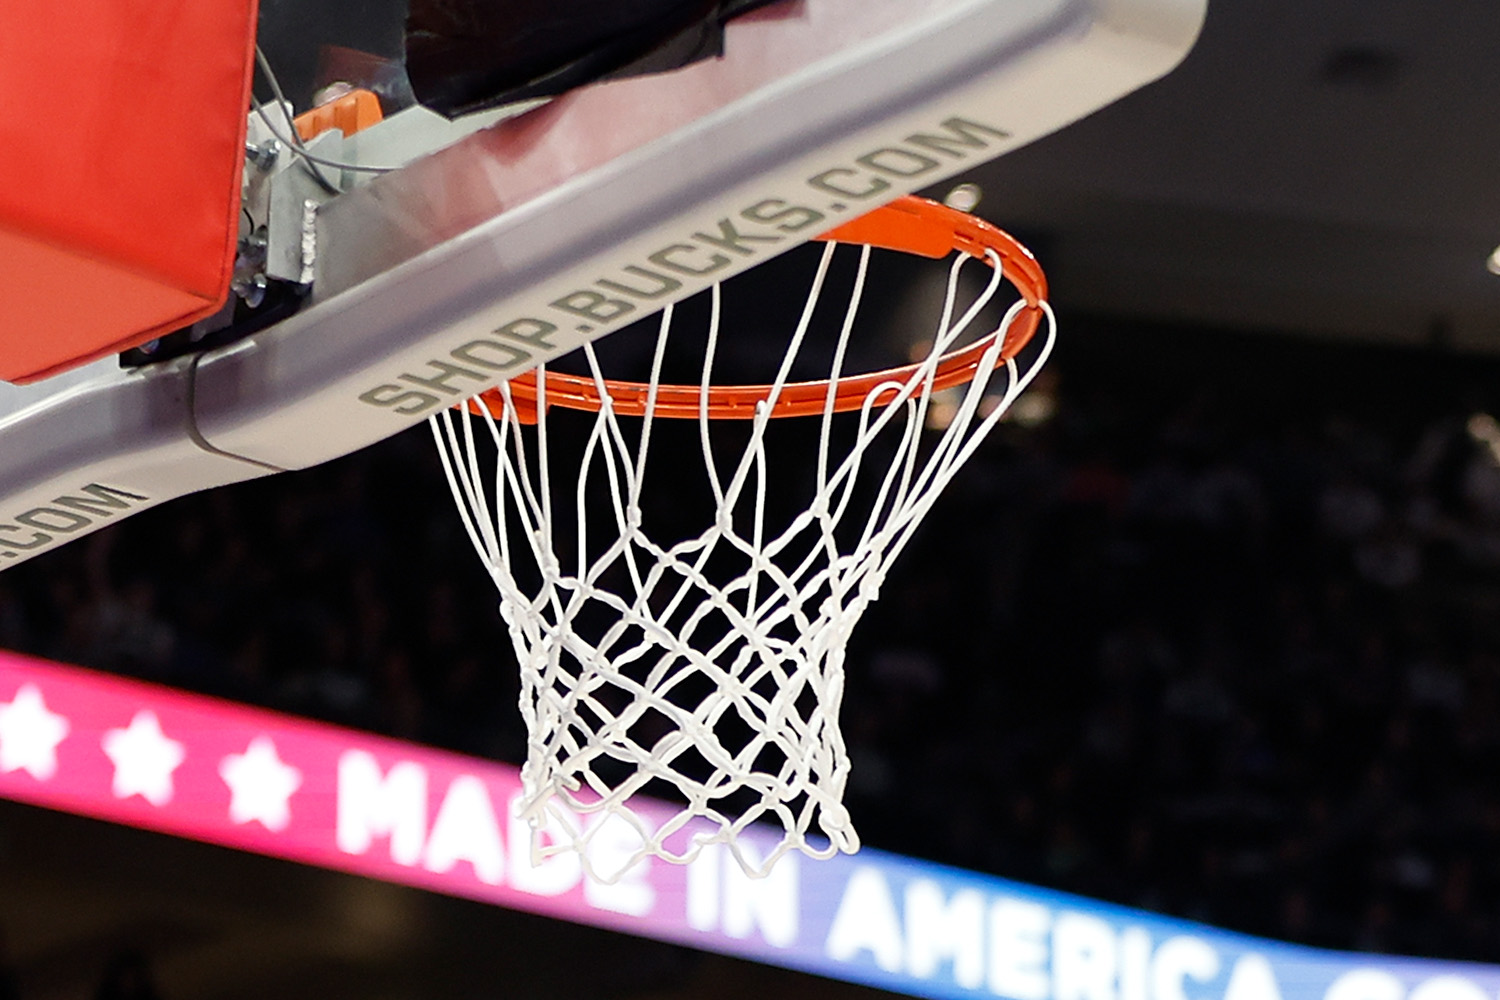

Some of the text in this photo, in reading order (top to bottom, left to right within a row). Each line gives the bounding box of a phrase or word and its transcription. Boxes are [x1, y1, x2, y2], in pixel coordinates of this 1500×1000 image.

[358, 115, 1012, 416] SHOP.BUCKS.COM
[336, 748, 656, 918] MADE
[688, 832, 798, 949] IN
